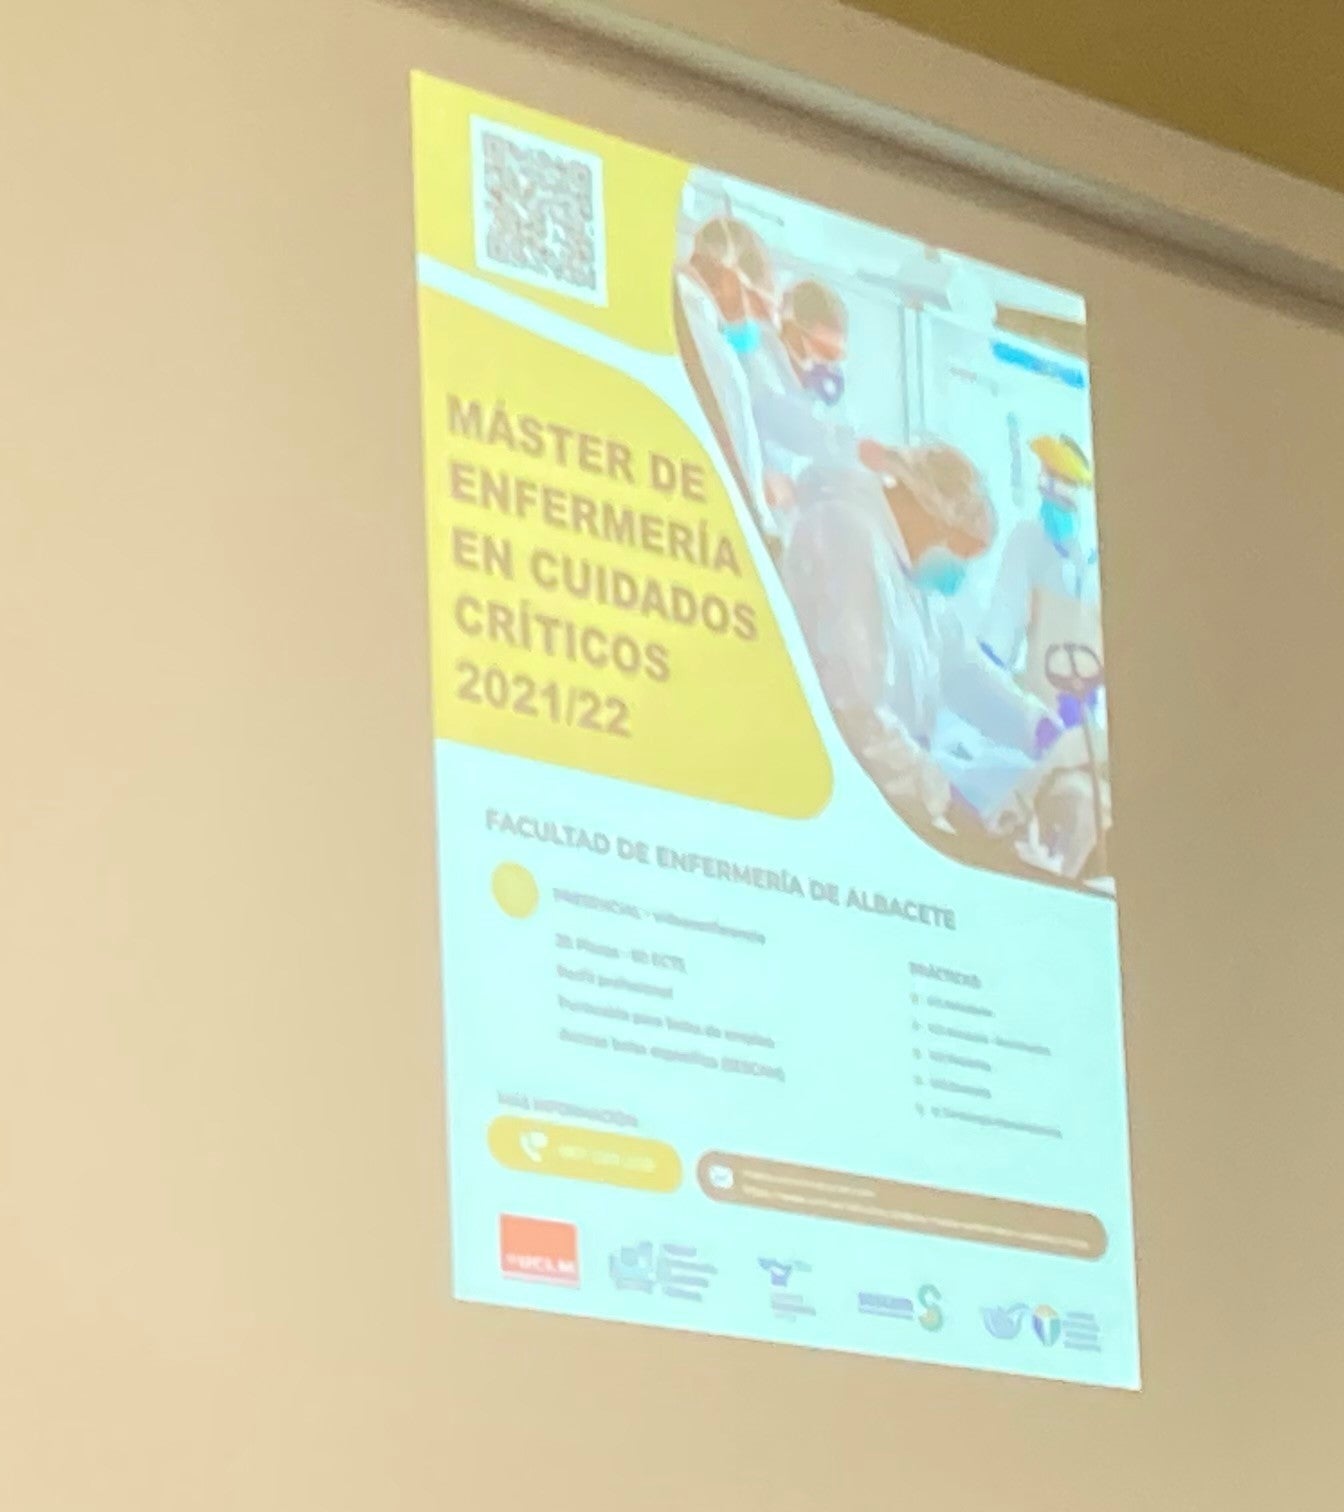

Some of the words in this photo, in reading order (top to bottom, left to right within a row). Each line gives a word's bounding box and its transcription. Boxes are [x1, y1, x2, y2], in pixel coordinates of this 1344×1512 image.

[447, 393, 635, 484] MÁSTER
[650, 451, 708, 504] DE
[450, 459, 742, 577] ENFERMERÍA
[452, 526, 514, 580] EN
[530, 546, 758, 641] CUIDADOS
[454, 595, 670, 682] CRÍTICOS
[455, 660, 632, 738] 2021/22
[486, 808, 610, 855] FACULTAD
[617, 836, 650, 864] DE
[656, 845, 805, 898] ENFERMERÍA
[809, 878, 840, 906] DE
[847, 886, 957, 930] ALBACETE
